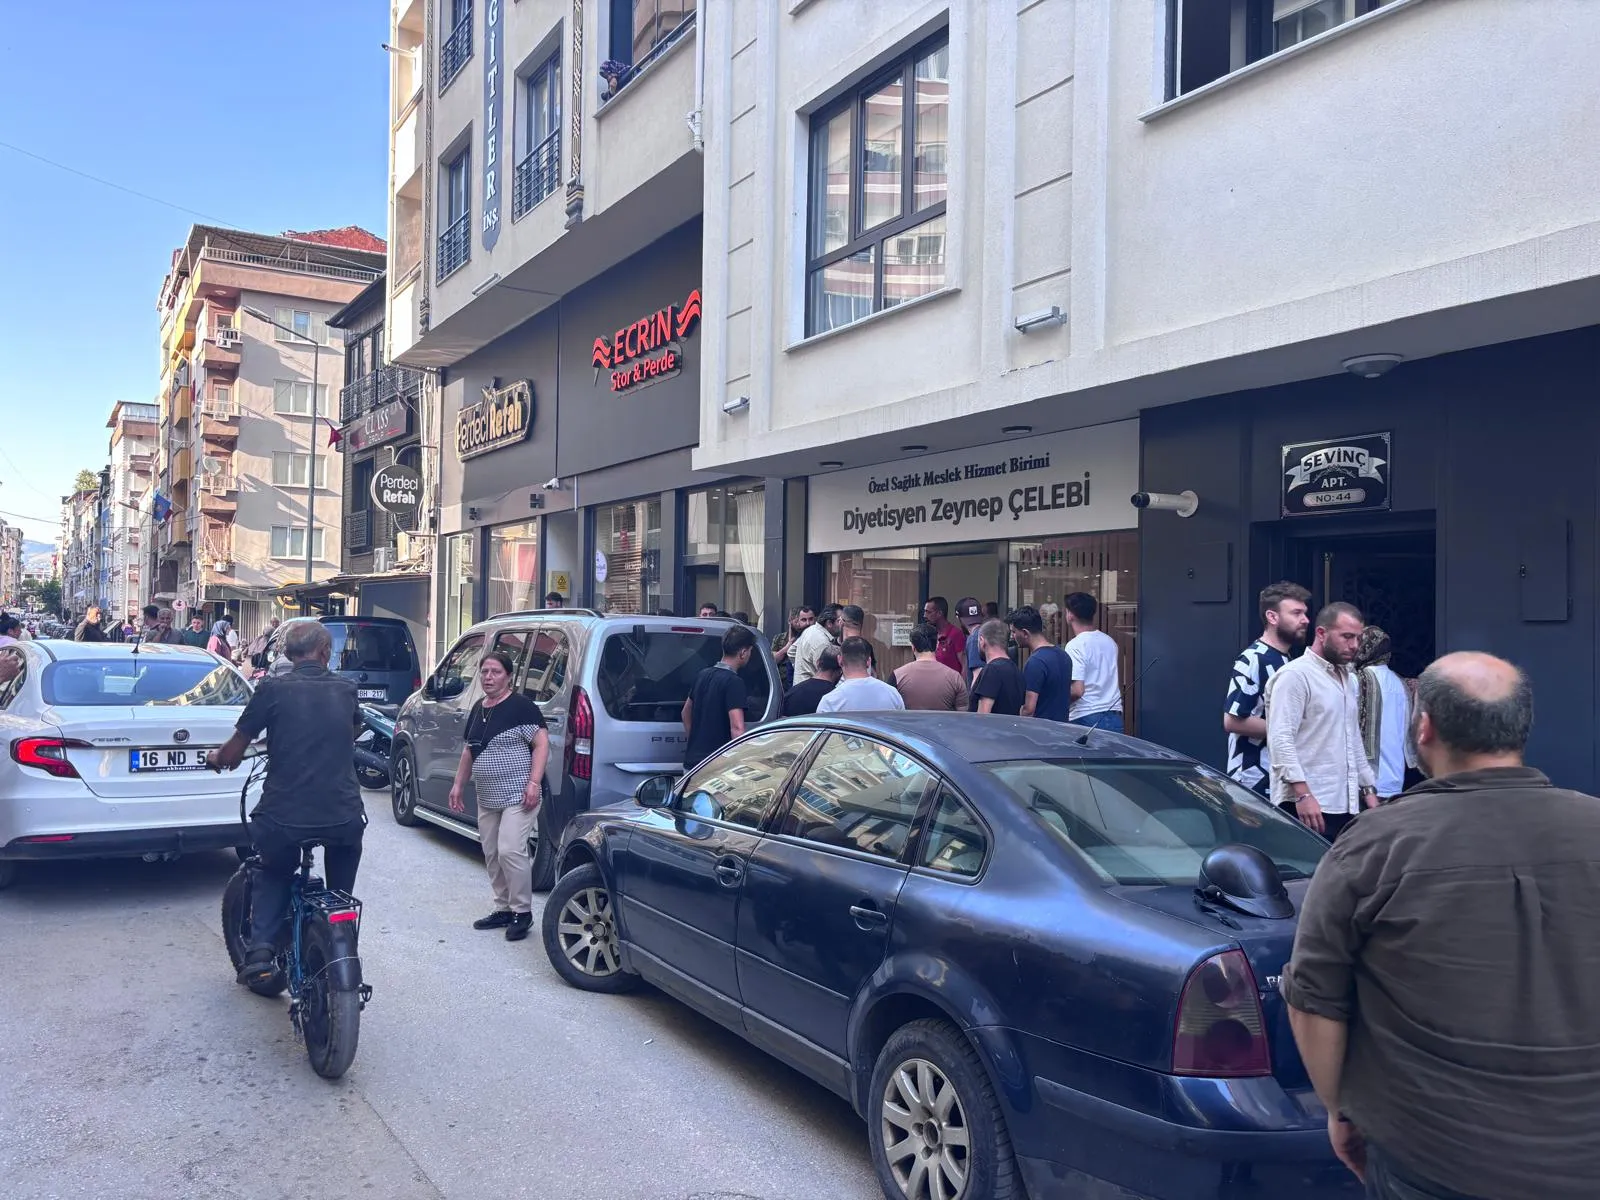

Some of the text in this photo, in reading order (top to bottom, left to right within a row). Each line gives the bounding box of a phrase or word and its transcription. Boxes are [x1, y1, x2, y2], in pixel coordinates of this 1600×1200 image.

[610, 349, 675, 392] Stor & Perde
[489, 391, 523, 440] Refah
[1303, 447, 1366, 472] SEVİNÇ
[868, 452, 1051, 494] Özel Sağlık Meslek Hizmet Birimi
[1321, 476, 1348, 489] APT.
[382, 489, 416, 505] Refah
[843, 471, 1091, 535] Diyetisyen Zeynep ÇELEBİ
[1315, 492, 1351, 503] NO:44
[372, 690, 383, 698] 217
[141, 750, 207, 767] 16 ND 5
